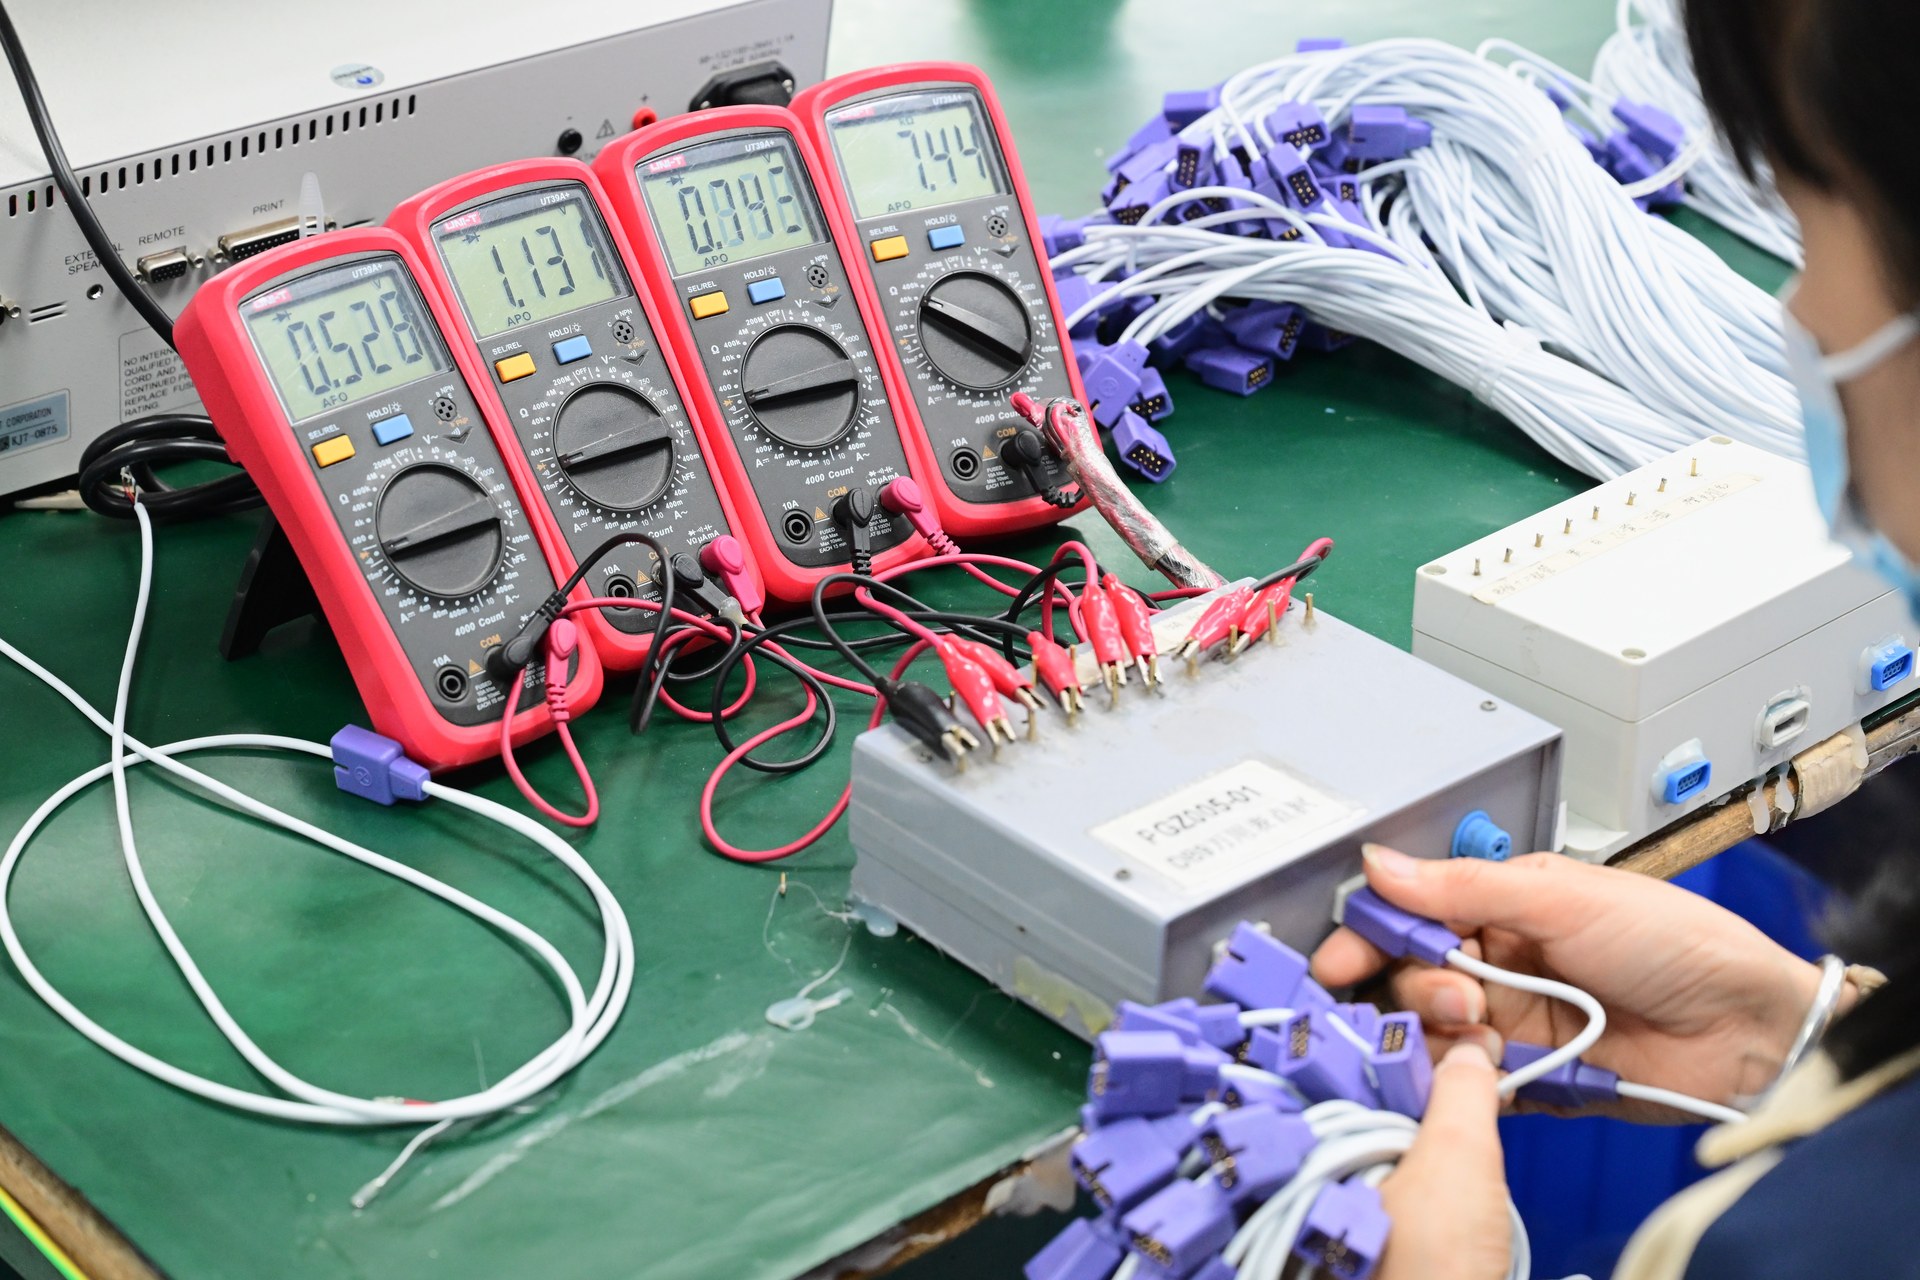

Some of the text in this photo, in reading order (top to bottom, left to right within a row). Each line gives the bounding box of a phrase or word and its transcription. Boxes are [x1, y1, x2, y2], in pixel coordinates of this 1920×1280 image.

[744, 140, 775, 152] UT39A+
[897, 122, 986, 191] 7.44
[540, 192, 571, 206] UT39A+
[252, 200, 285, 215] PRINT
[888, 200, 912, 212] APO
[444, 212, 479, 230] UNI-T
[138, 226, 185, 246] REMOTE
[869, 226, 899, 236] SEL/REL
[65, 243, 124, 265] EXTEAL
[814, 254, 829, 263] NPN
[704, 254, 729, 268] APO
[352, 264, 383, 279] UT39A+
[688, 281, 717, 293] SEL/REL
[619, 308, 633, 317] NPN
[507, 312, 532, 327] APO
[746, 316, 765, 326] 200M
[738, 328, 749, 336] 4M
[830, 323, 842, 331] 750
[895, 324, 909, 332] 400
[846, 334, 860, 343] 1000
[492, 342, 523, 356] SEL/REL
[710, 344, 720, 355] Ω
[724, 340, 741, 349] 400k
[124, 357, 138, 367] NO
[722, 354, 736, 363] 40k
[124, 358, 171, 377] QUALIFIED
[575, 366, 587, 376] OFF
[608, 366, 617, 374] 40
[124, 373, 152, 387] CORD
[156, 366, 176, 378] AND
[622, 371, 633, 379] 400
[552, 376, 571, 386] 200M
[124, 376, 177, 397] CONTINUED
[718, 384, 732, 392] 400
[124, 389, 168, 407] REPLACE
[546, 389, 557, 397] 4M
[654, 388, 669, 398] 1000
[532, 401, 550, 411] 400k
[868, 398, 886, 407] 400m
[520, 408, 529, 418] Ω
[666, 404, 678, 412] 400
[532, 417, 546, 426] 40k
[728, 416, 744, 427] 10mF
[866, 416, 881, 425] hFE
[975, 414, 995, 425] 4000
[308, 424, 340, 440] SEL/REL
[533, 432, 543, 440] 4k
[996, 427, 1017, 438] COM
[848, 442, 866, 451] 400m
[952, 437, 969, 448] 10A
[396, 448, 409, 458] OFF
[530, 448, 544, 457] 400
[682, 453, 700, 462] 400m
[774, 452, 785, 460] 4m
[464, 456, 476, 465] 750
[786, 459, 801, 467] 40m
[802, 459, 820, 469] 400m
[822, 458, 831, 466] 10
[480, 468, 495, 477] 1000
[682, 472, 697, 482] hFE
[805, 466, 854, 486] 4000 Count
[543, 480, 559, 491] 10mF
[674, 488, 688, 497] 40m
[828, 486, 849, 498] COM
[339, 494, 350, 505] Ω
[503, 500, 512, 508] 40
[666, 500, 684, 510] 400m
[782, 500, 800, 511] 10A
[354, 517, 366, 527] 4k
[592, 516, 603, 524] 4m
[604, 522, 619, 530] 40m
[620, 520, 638, 531] 400m
[820, 527, 836, 536] FUSED
[512, 533, 530, 545] 400m
[511, 553, 528, 565] hFE
[504, 571, 520, 580] 40m
[603, 565, 621, 576] 10A
[496, 583, 515, 595] 400m
[486, 598, 495, 606] 10
[432, 608, 448, 619] 40m
[448, 607, 469, 619] 400m
[471, 606, 480, 615] 10
[455, 622, 476, 637] 4000
[478, 610, 506, 628] Count
[480, 634, 502, 649] COM
[433, 654, 452, 668] 10A
